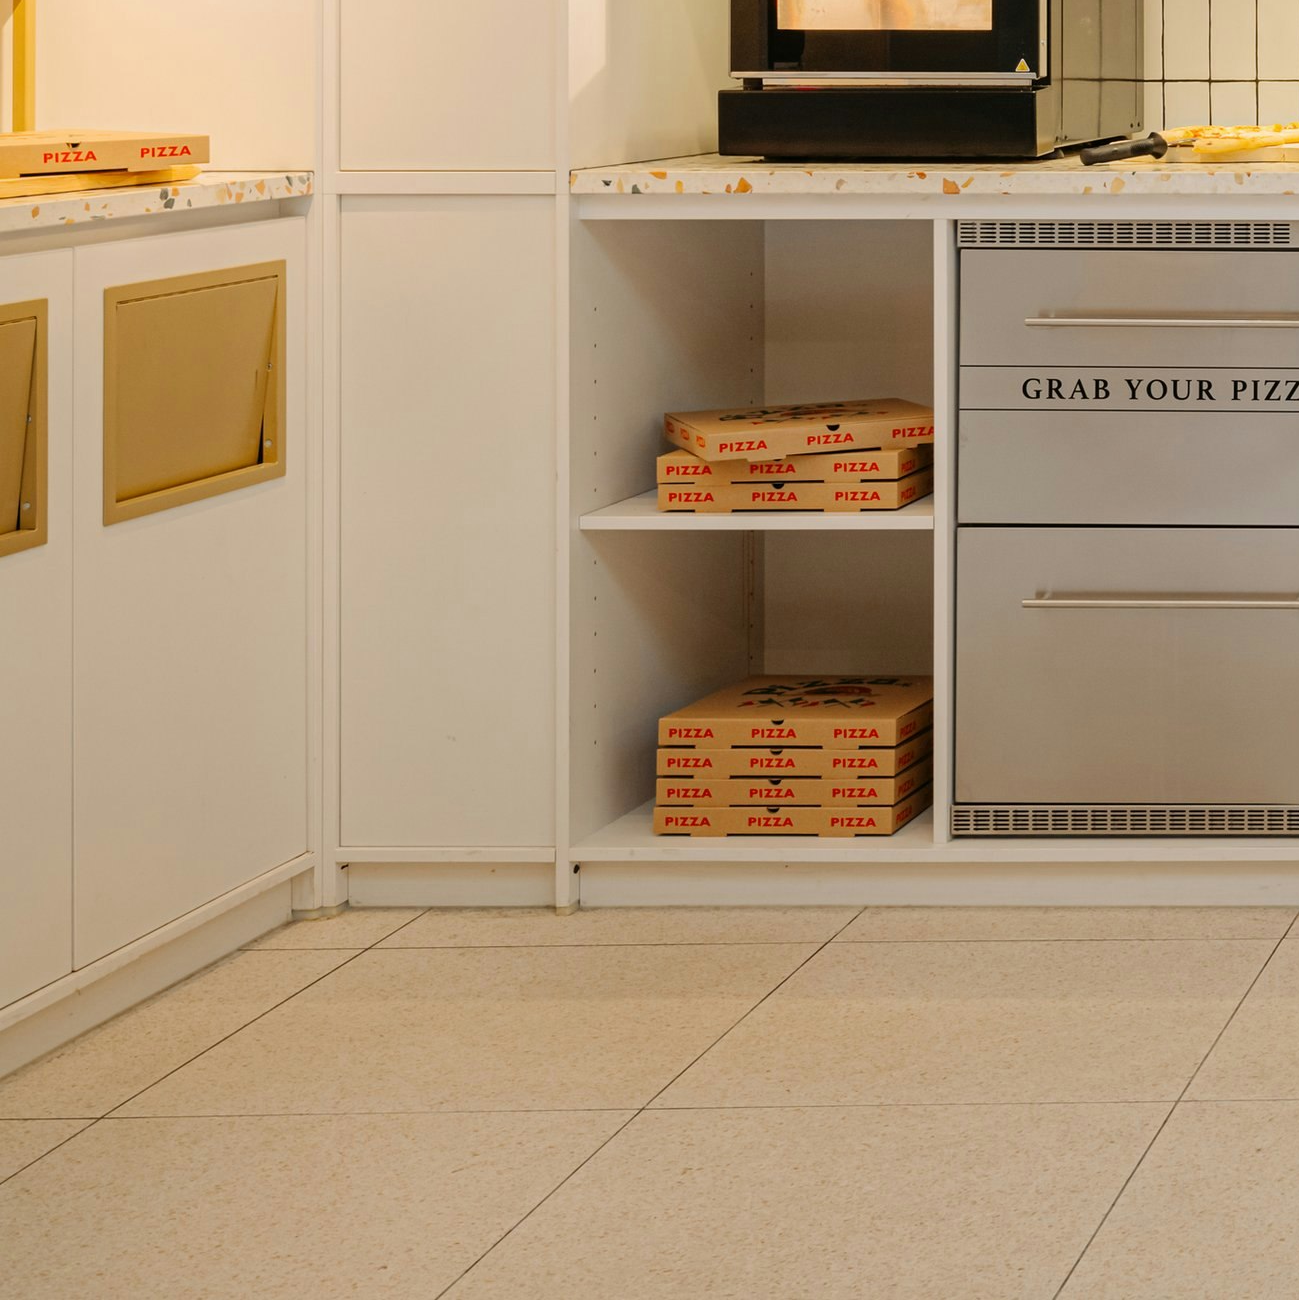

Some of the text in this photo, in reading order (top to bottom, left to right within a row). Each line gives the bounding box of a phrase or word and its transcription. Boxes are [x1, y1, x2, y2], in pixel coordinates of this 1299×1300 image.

[43, 150, 97, 164] PIZZA
[140, 145, 191, 159] PIZZA
[1022, 378, 1110, 399] GRAB
[1125, 379, 1216, 400] YOUR
[892, 425, 934, 439] PIZZA
[807, 432, 854, 446] PIZZA
[719, 440, 768, 454] PIZZA
[666, 465, 712, 476] PIZZA
[750, 463, 796, 474] PIZZA
[833, 462, 880, 473] PIZZA
[668, 492, 714, 503] PIZZA
[752, 491, 798, 502] PIZZA
[835, 491, 881, 501] PIZZA
[669, 728, 714, 739] PIZZA
[751, 728, 797, 739] PIZZA
[833, 728, 879, 739] PIZZA
[667, 757, 713, 768] PIZZA
[750, 757, 796, 768] PIZZA
[832, 758, 878, 769] PIZZA
[667, 788, 712, 799] PIZZA
[749, 788, 795, 799] PIZZA
[832, 787, 878, 798] PIZZA
[665, 816, 711, 827] PIZZA
[748, 816, 793, 827] PIZZA
[831, 817, 876, 828] PIZZA
